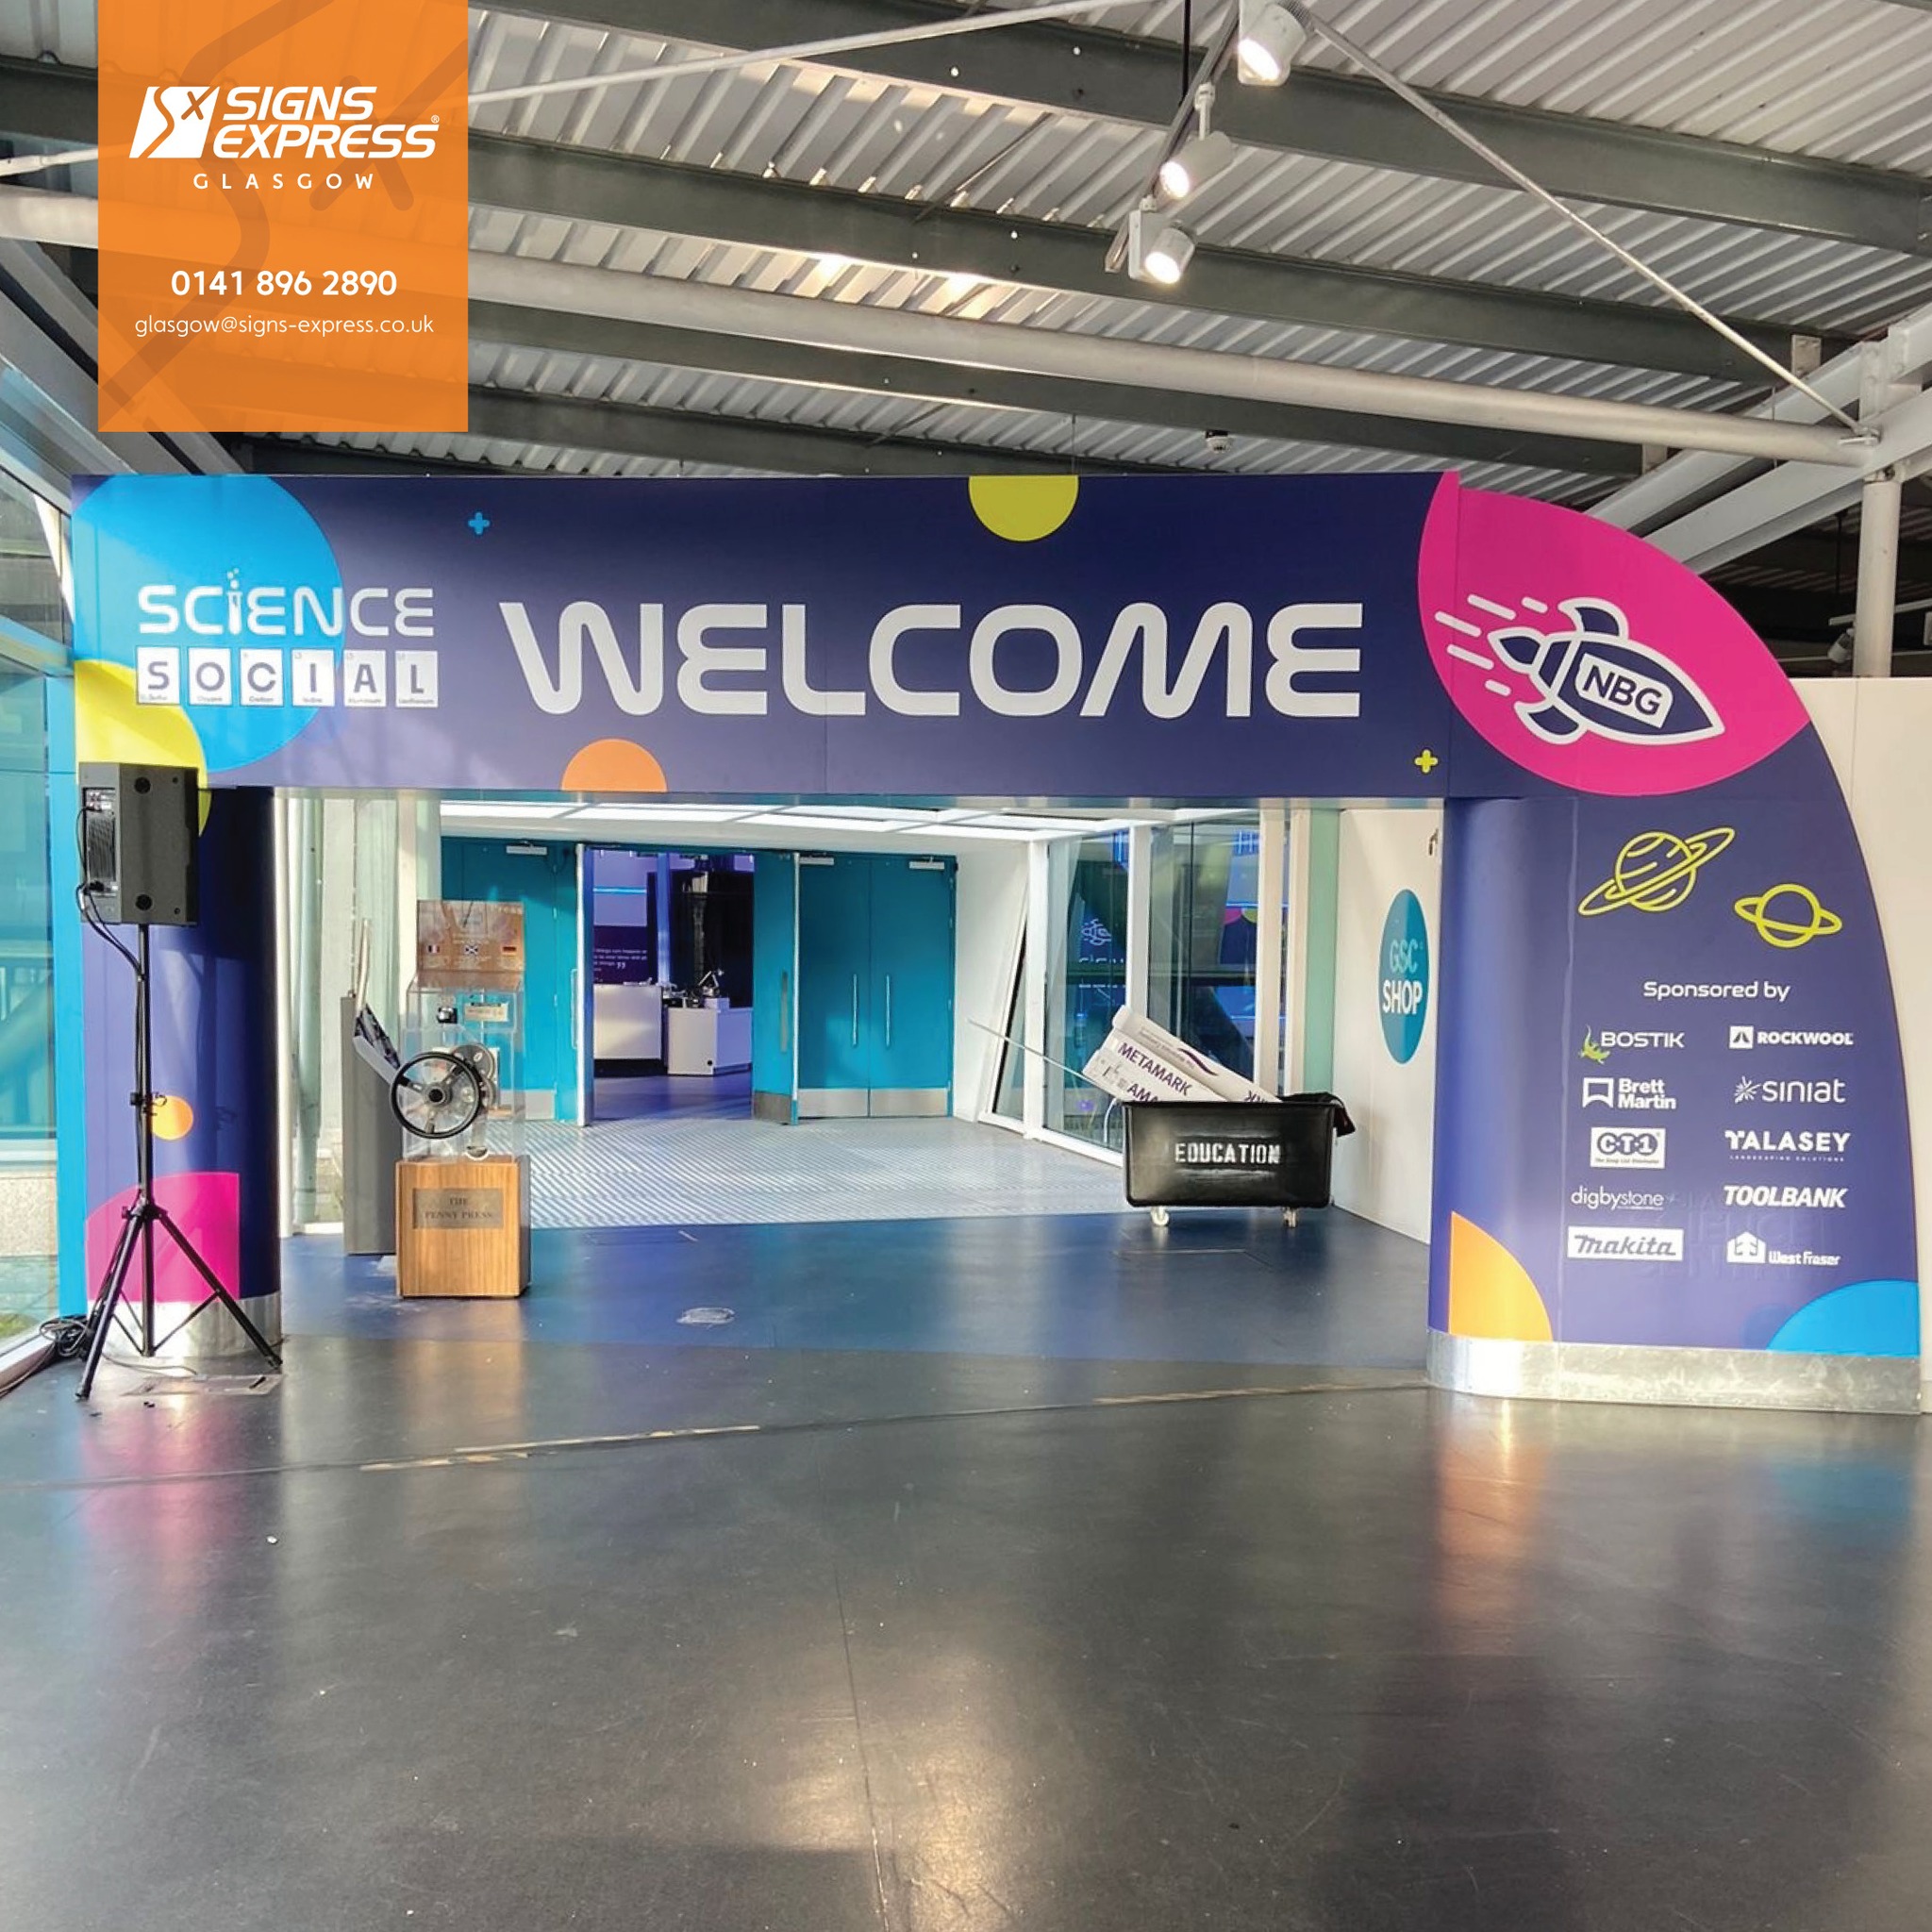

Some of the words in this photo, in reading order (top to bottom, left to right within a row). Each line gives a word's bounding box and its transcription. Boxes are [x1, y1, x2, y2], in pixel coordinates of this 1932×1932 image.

[498, 600, 1364, 719] WELCOME
[145, 659, 426, 695] SOCIAL
[1582, 664, 1662, 716] NBG
[1381, 979, 1424, 1015] SHOP
[1642, 980, 1758, 1002] Sponsored
[1763, 980, 1791, 1003] by
[1600, 1031, 1685, 1048] BOSTIK
[1757, 1031, 1854, 1045] ROCKWOOL
[1117, 1041, 1193, 1096] METAMARK
[1618, 1077, 1665, 1093] Brett
[1617, 1093, 1677, 1109] Martin
[1724, 1129, 1852, 1153] TALASEY
[1174, 1142, 1281, 1165] EDUCATION
[1724, 1185, 1849, 1208] TOOLBANK
